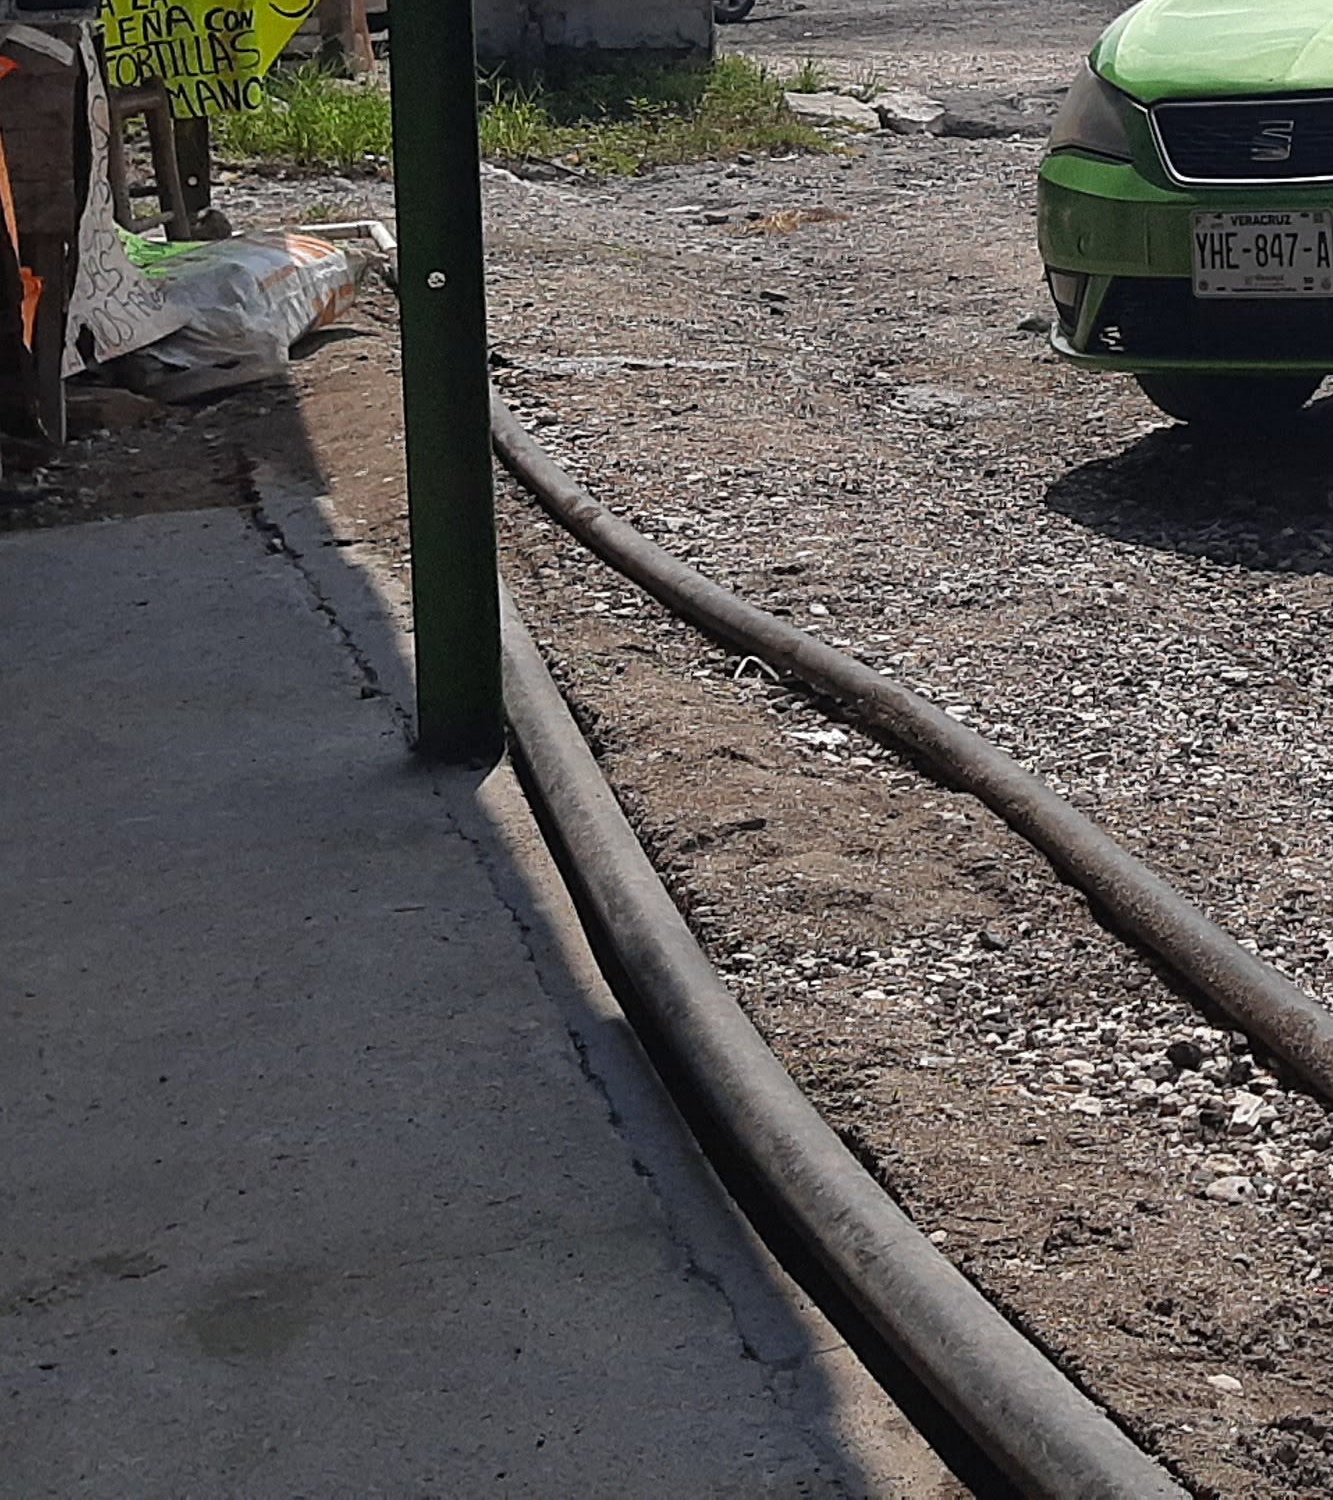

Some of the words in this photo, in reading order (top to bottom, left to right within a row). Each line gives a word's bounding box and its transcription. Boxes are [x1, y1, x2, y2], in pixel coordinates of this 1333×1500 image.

[204, 7, 254, 33] CON
[1230, 214, 1293, 227] VERACRUZ
[1195, 230, 1331, 270] YHE-847-A
